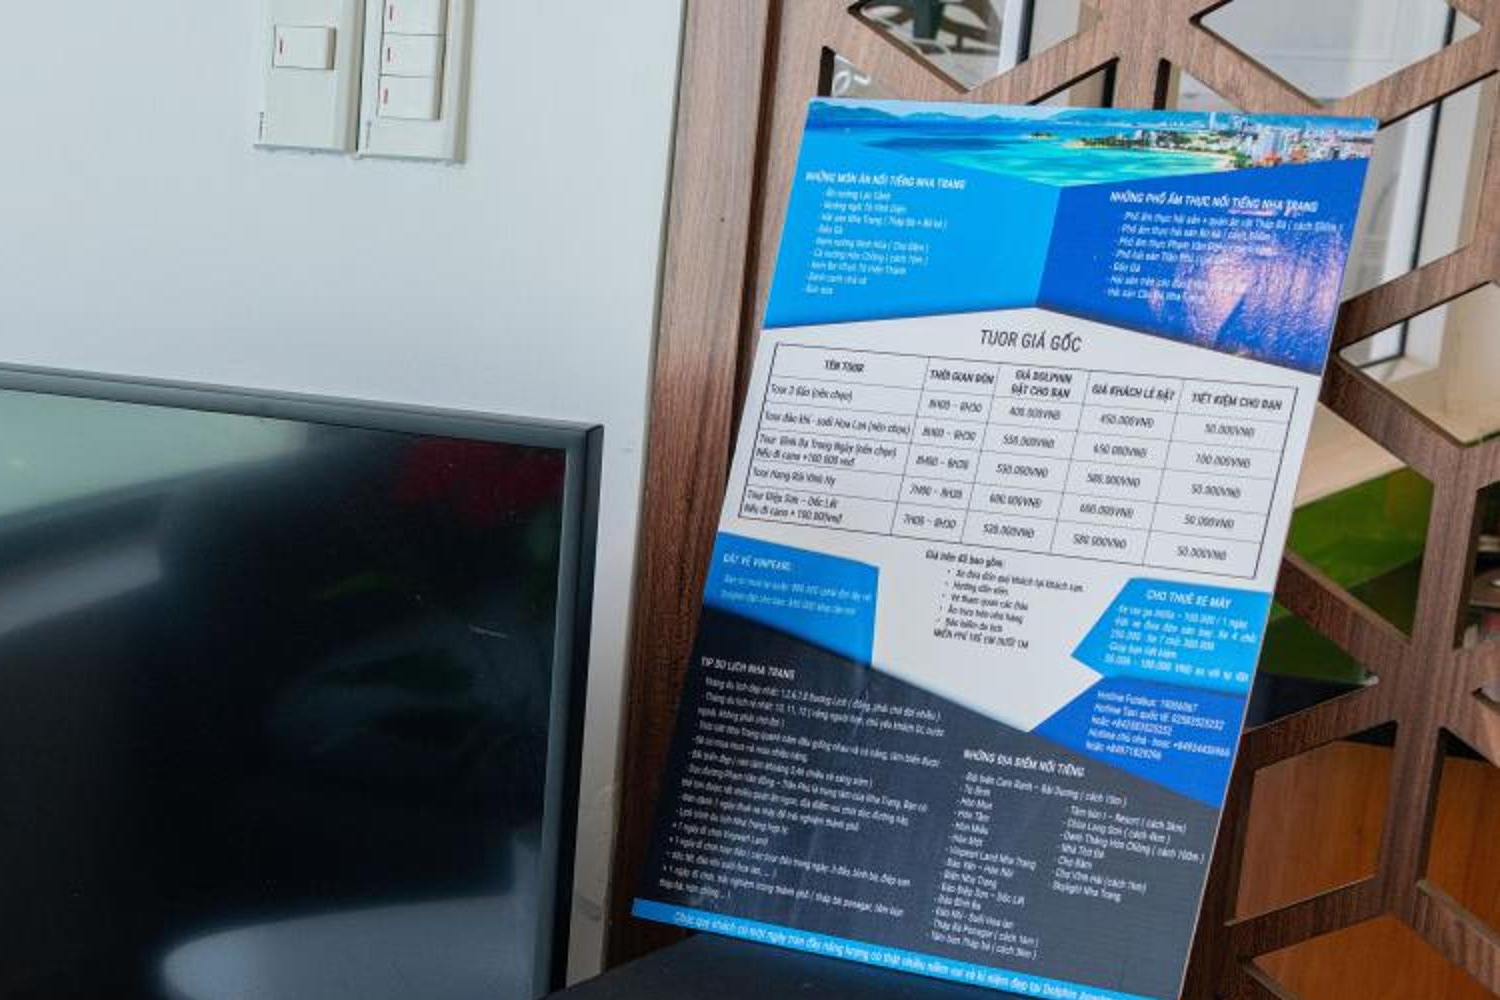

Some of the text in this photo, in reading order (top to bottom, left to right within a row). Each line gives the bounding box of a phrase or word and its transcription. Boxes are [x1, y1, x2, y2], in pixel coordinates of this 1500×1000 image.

[1260, 198, 1284, 211] NHA
[978, 326, 1084, 350] TUOR GIÁ GỐC
[951, 370, 974, 382] GIAN
[1108, 385, 1142, 399] KHÁCH
[1146, 587, 1232, 609] CHO THUÊ XE MÁY
